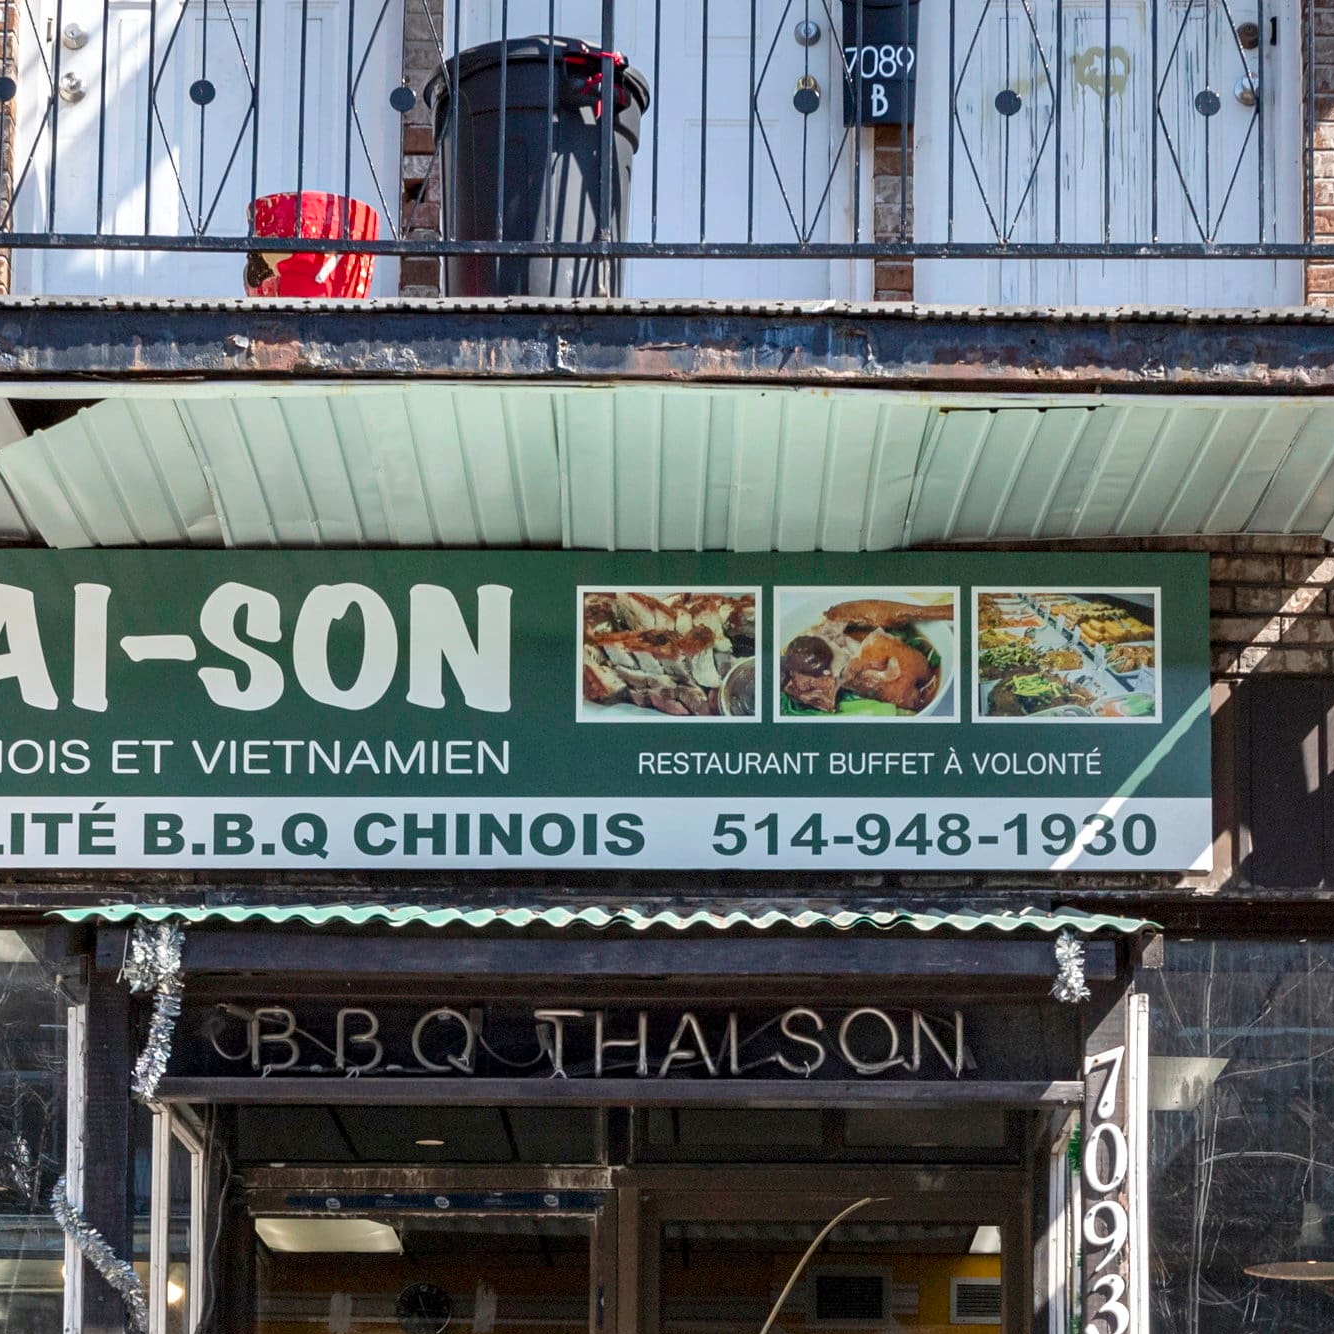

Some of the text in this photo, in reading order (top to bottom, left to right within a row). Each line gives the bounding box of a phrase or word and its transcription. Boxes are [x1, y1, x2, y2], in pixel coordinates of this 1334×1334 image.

[845, 45, 914, 81] 7089
[871, 84, 888, 117] B
[112, 739, 173, 775] ET
[190, 739, 510, 775] VIETNAMIEN
[638, 746, 1102, 776] RESTAURANT BUFFET À VOLONTÉ
[141, 814, 329, 860] B.B.Q
[353, 812, 645, 857] CHINOIS
[711, 812, 1158, 857] 514-948-1930
[533, 1008, 745, 1078] THAI
[775, 1007, 973, 1077] SON
